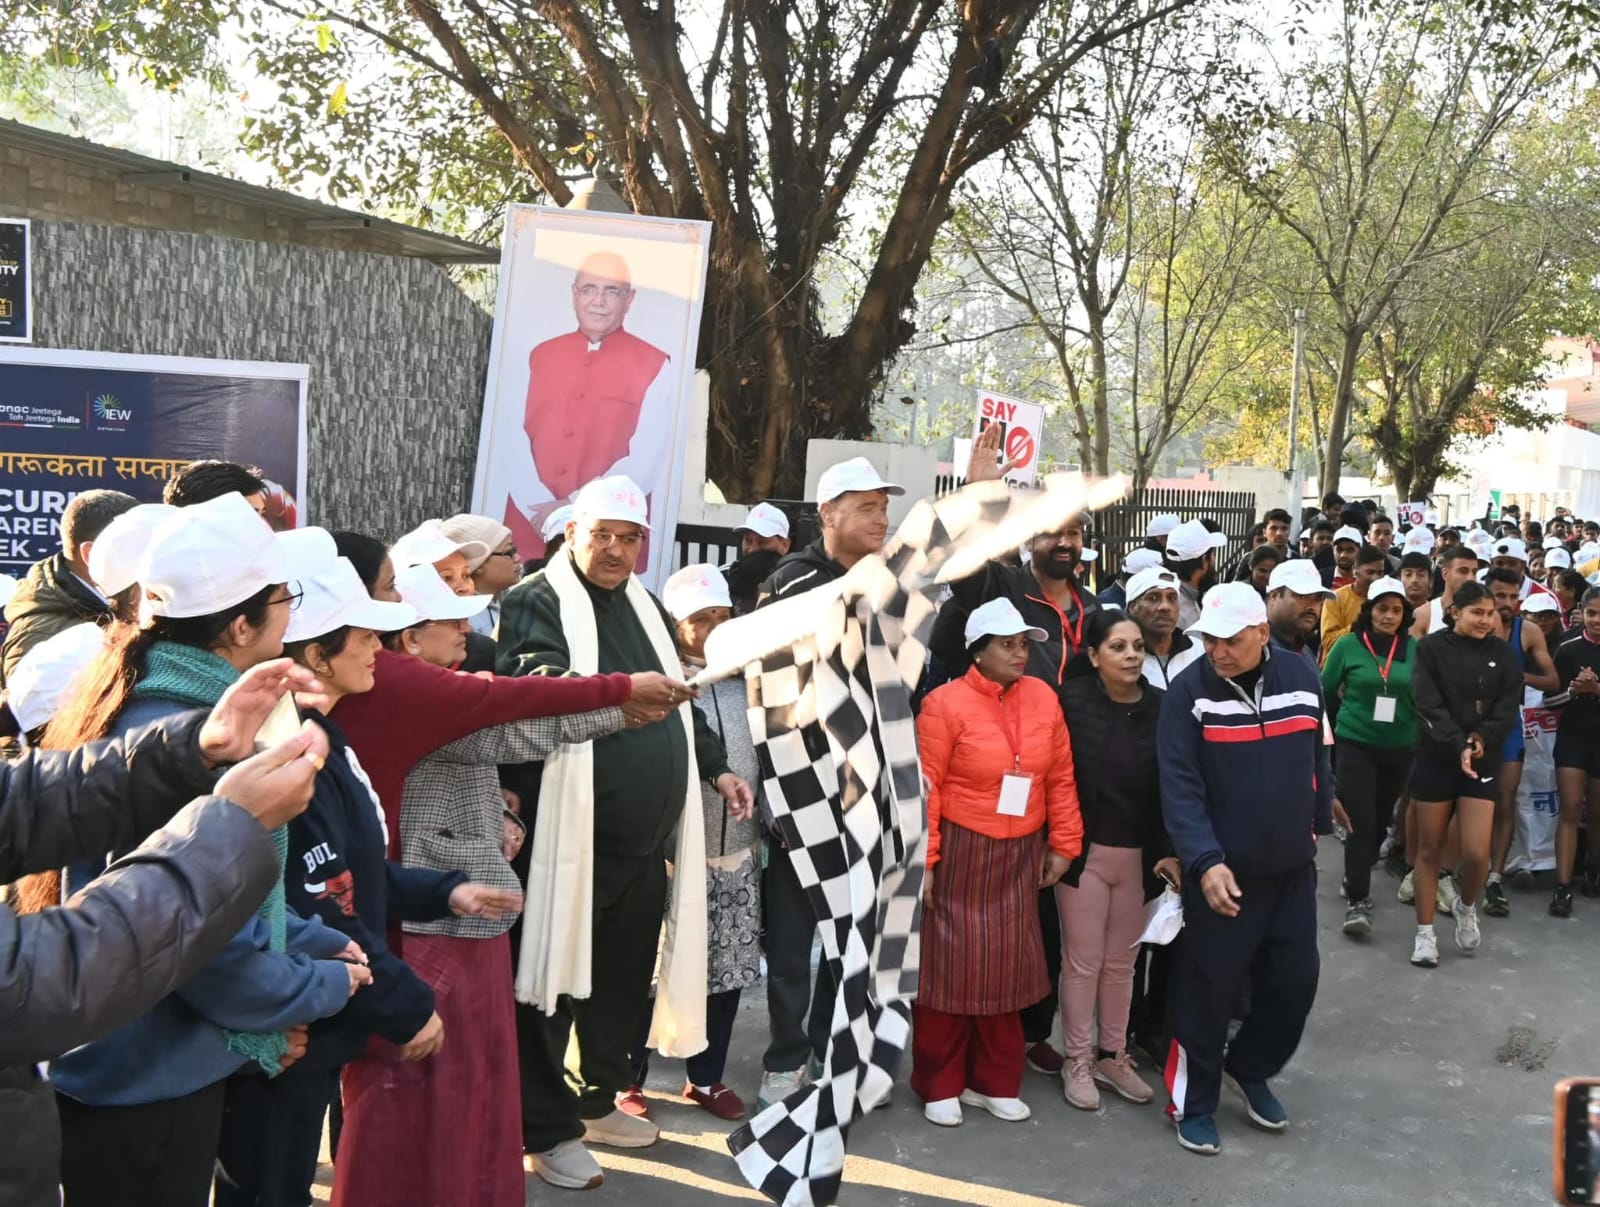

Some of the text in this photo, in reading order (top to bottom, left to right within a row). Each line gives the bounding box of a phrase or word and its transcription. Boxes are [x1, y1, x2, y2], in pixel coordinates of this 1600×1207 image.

[31, 407, 62, 416] Jeetega
[106, 408, 132, 421] IEW
[982, 398, 1016, 421] SAY
[8, 413, 81, 424] Toh Jeetega India
[303, 841, 338, 874] BUL
